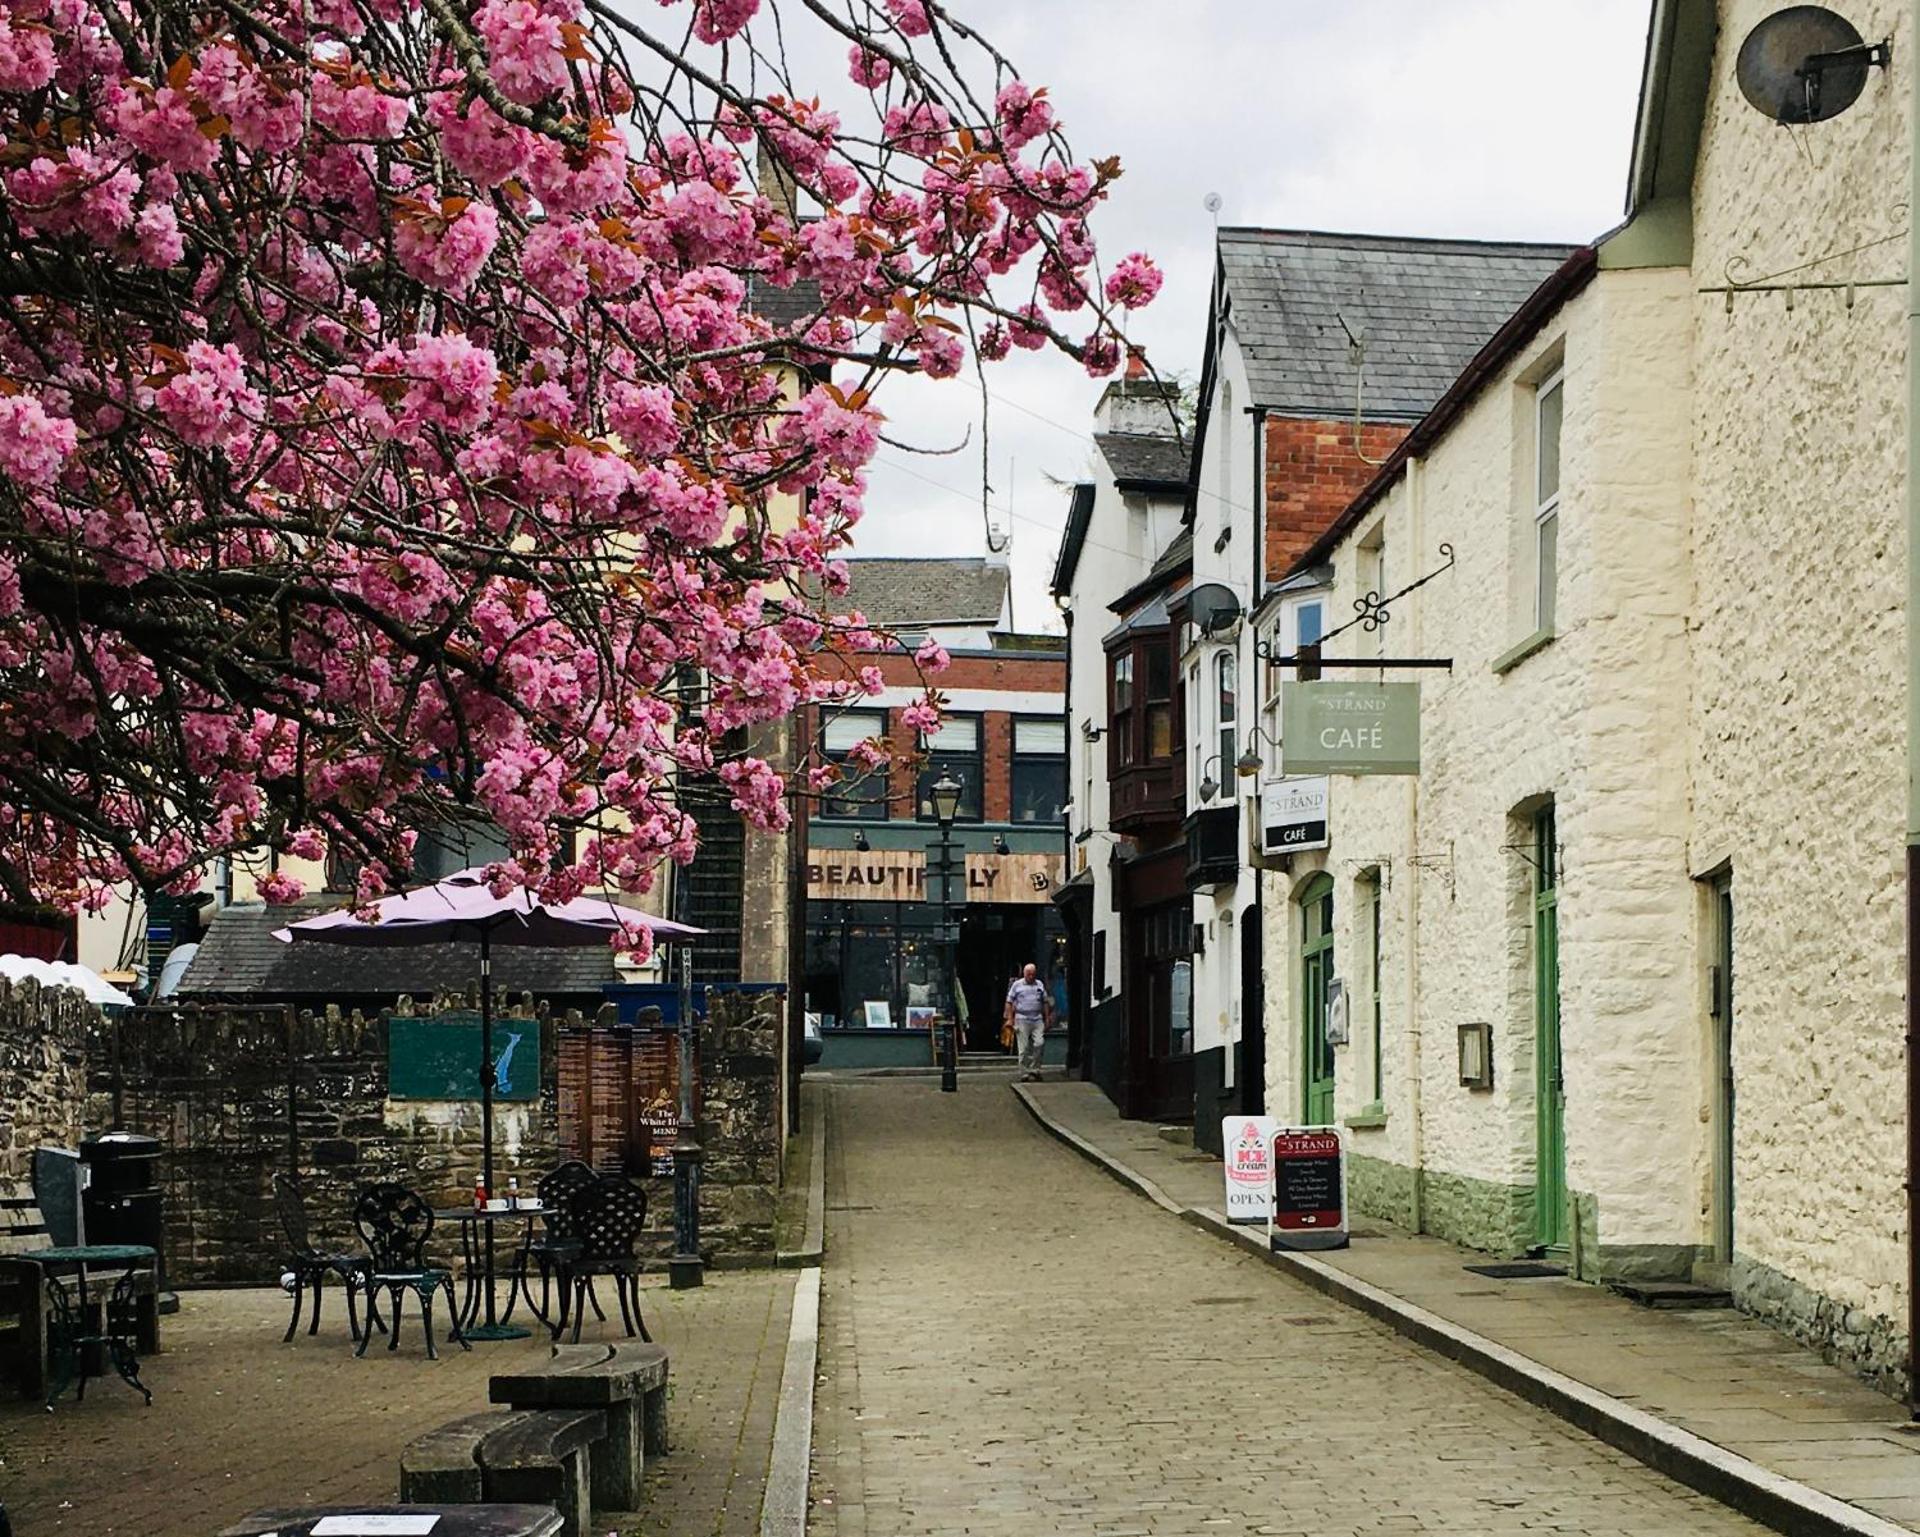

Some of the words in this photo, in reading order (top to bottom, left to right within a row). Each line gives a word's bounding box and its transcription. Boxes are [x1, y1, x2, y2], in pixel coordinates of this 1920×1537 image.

[1327, 698, 1386, 711] STRAND
[1320, 720, 1382, 749] CAFÉ
[1275, 793, 1324, 811] STRAND
[1284, 826, 1306, 842] CAFÉ
[807, 864, 1000, 888] BEAUTIFLY
[1287, 1140, 1335, 1151] STRAND
[1229, 1194, 1266, 1205] OPEN
